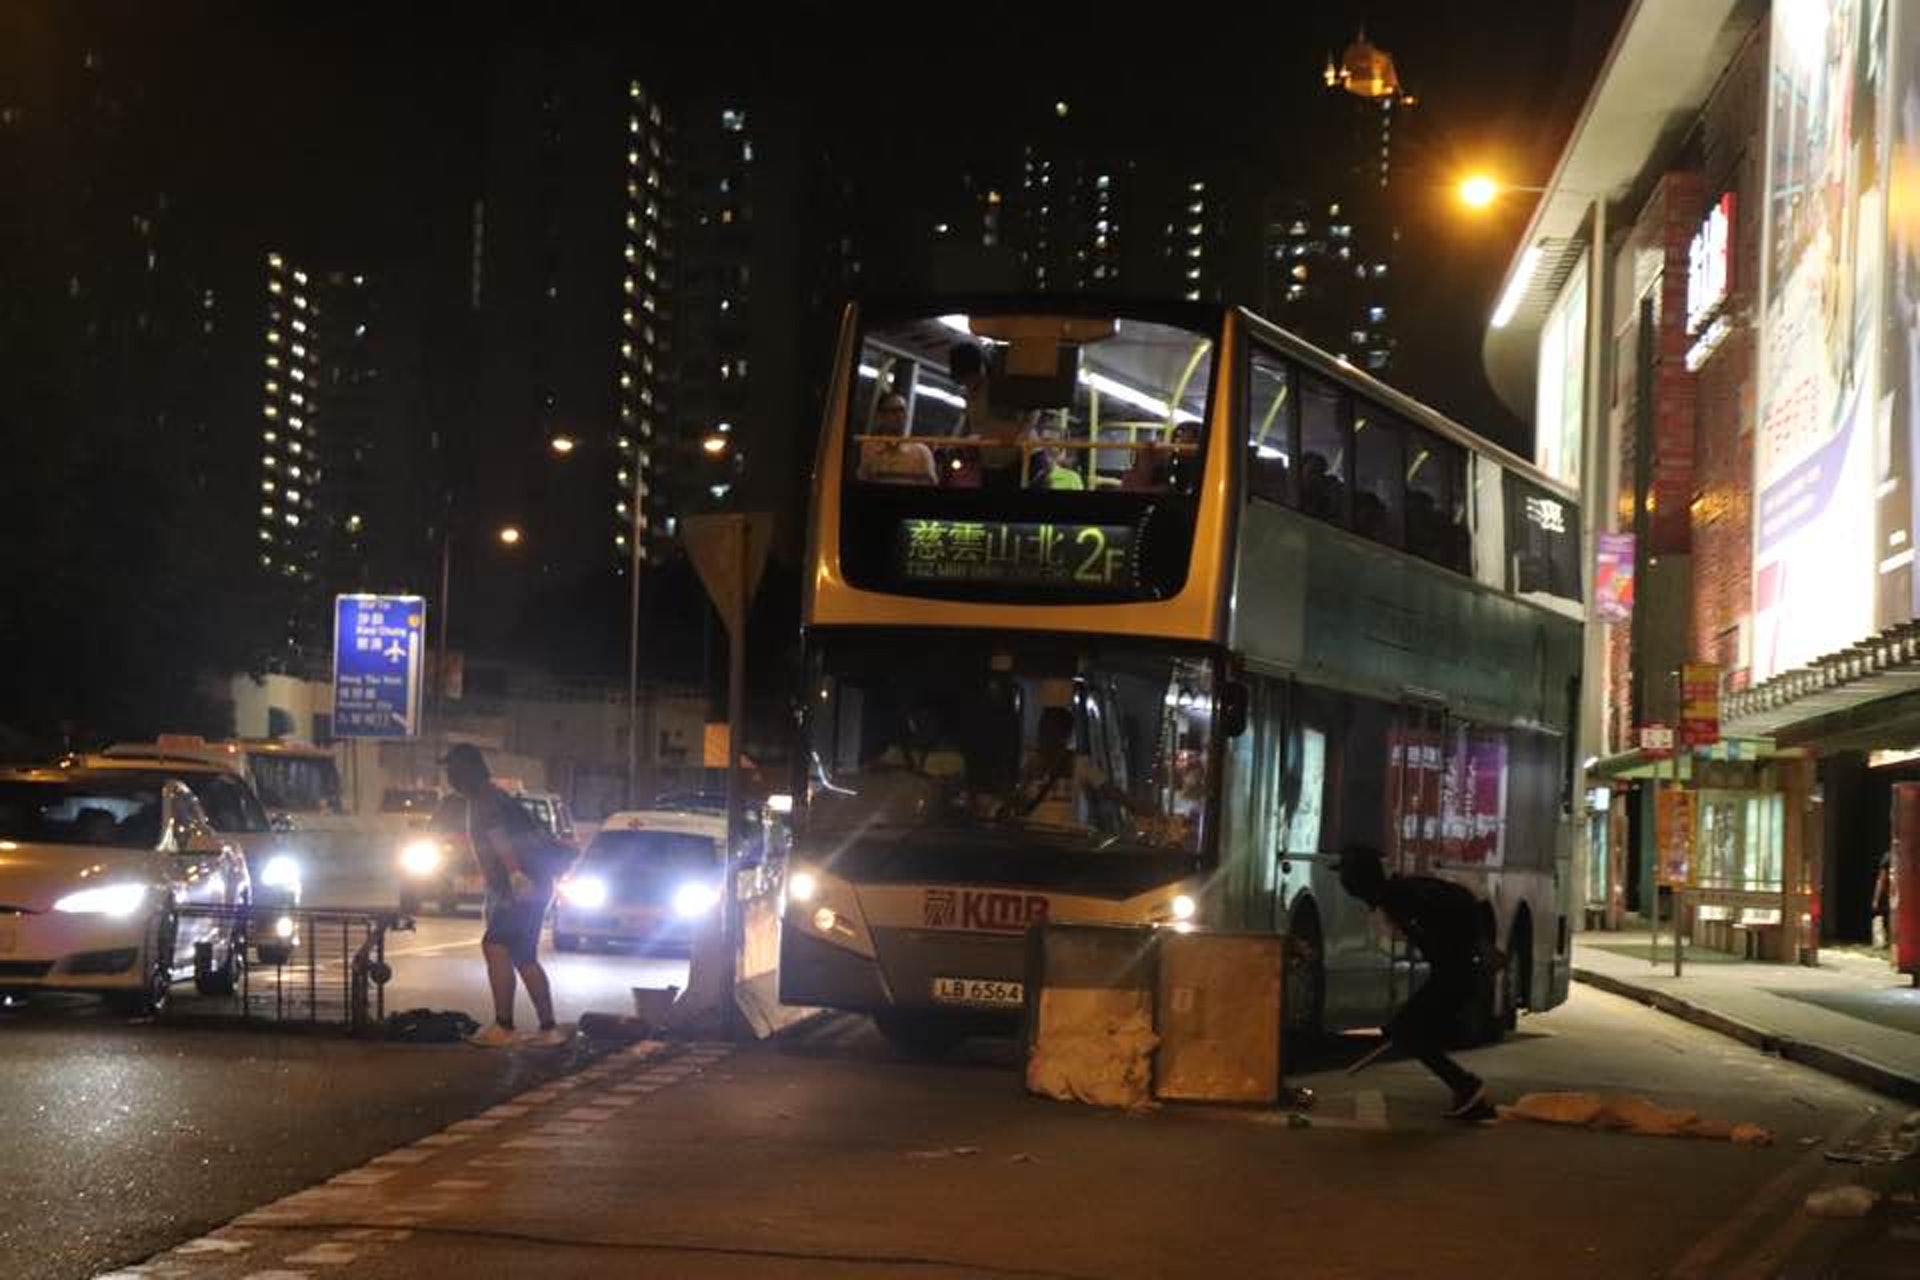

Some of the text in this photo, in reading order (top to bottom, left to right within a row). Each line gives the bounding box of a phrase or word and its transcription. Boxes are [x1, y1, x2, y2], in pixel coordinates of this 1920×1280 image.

[909, 519, 1125, 583] 慈雲山北 2F
